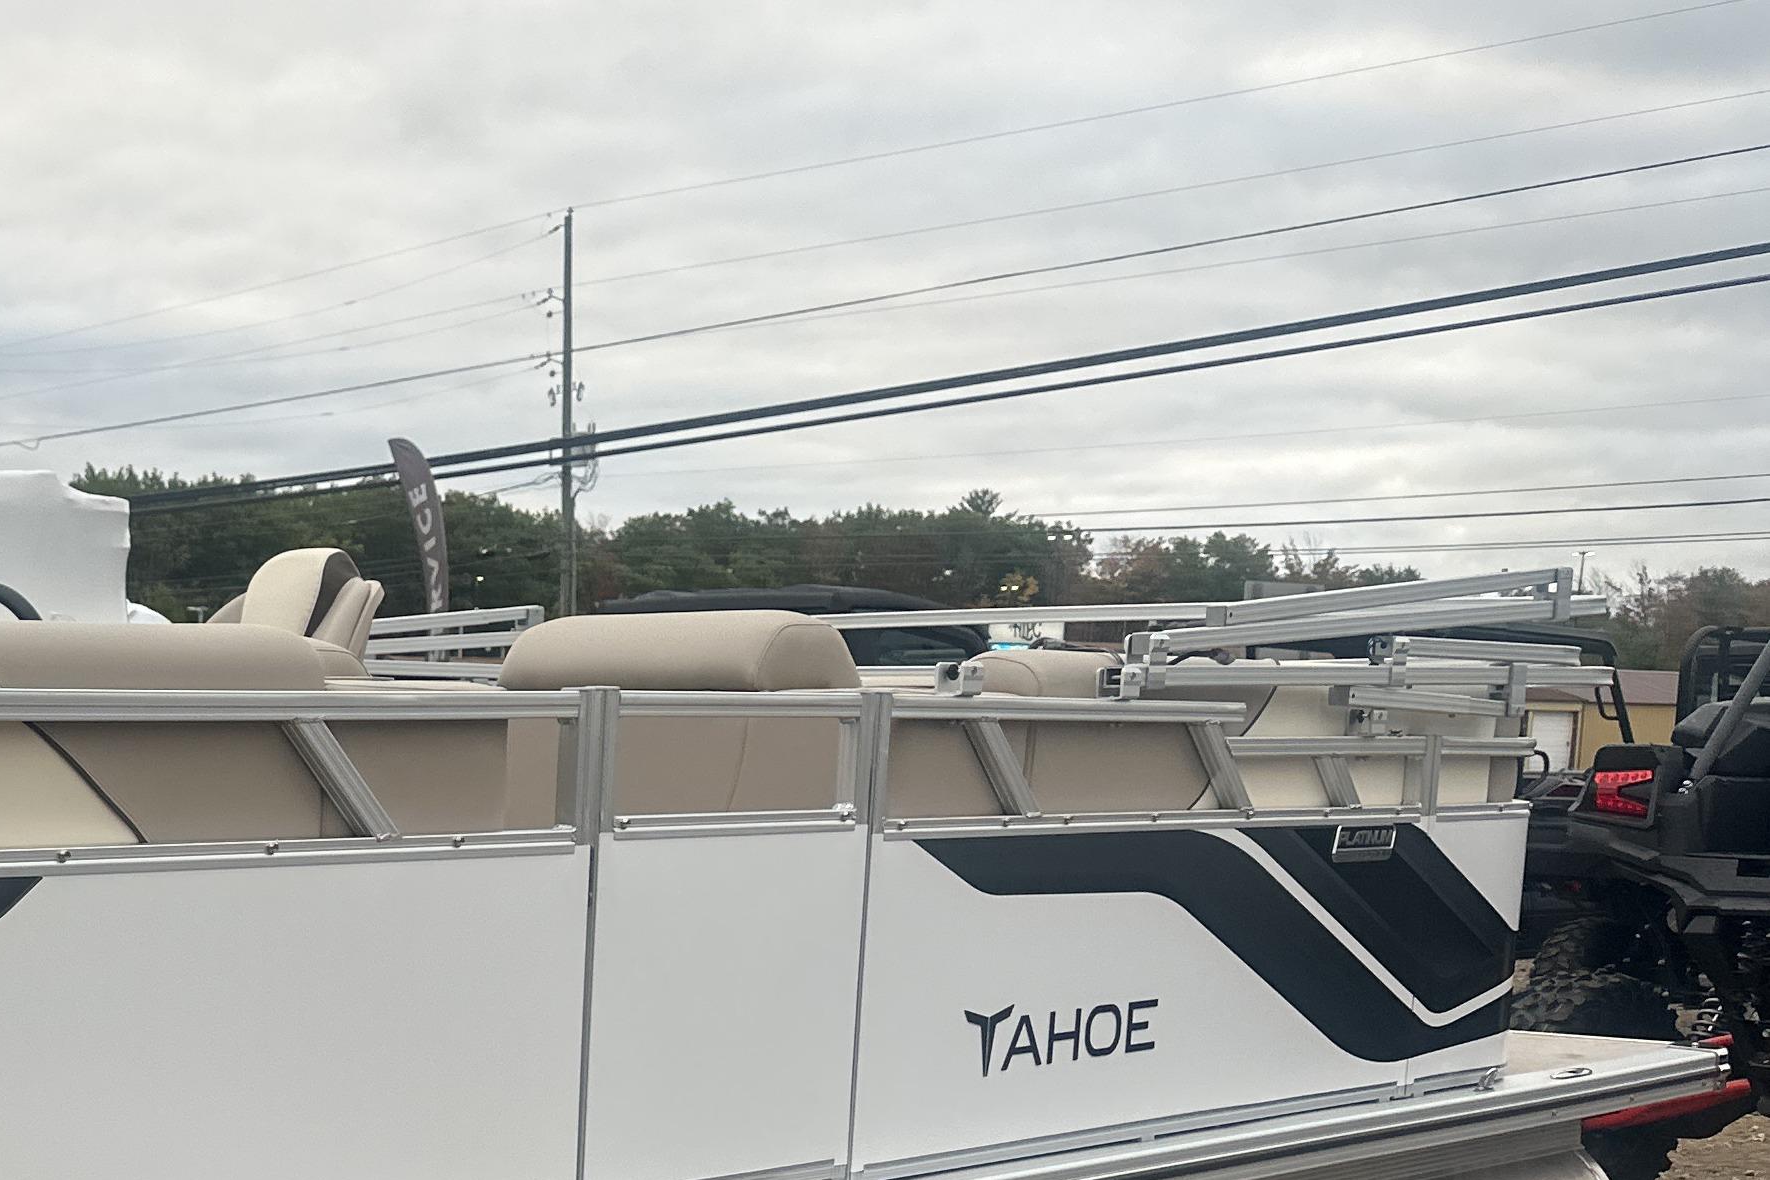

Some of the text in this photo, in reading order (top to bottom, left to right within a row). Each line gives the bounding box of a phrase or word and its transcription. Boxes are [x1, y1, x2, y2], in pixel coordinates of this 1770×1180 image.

[407, 483, 445, 661] RVICE
[1338, 829, 1394, 847] PLATINUM
[964, 998, 1159, 1077] TAHOE
